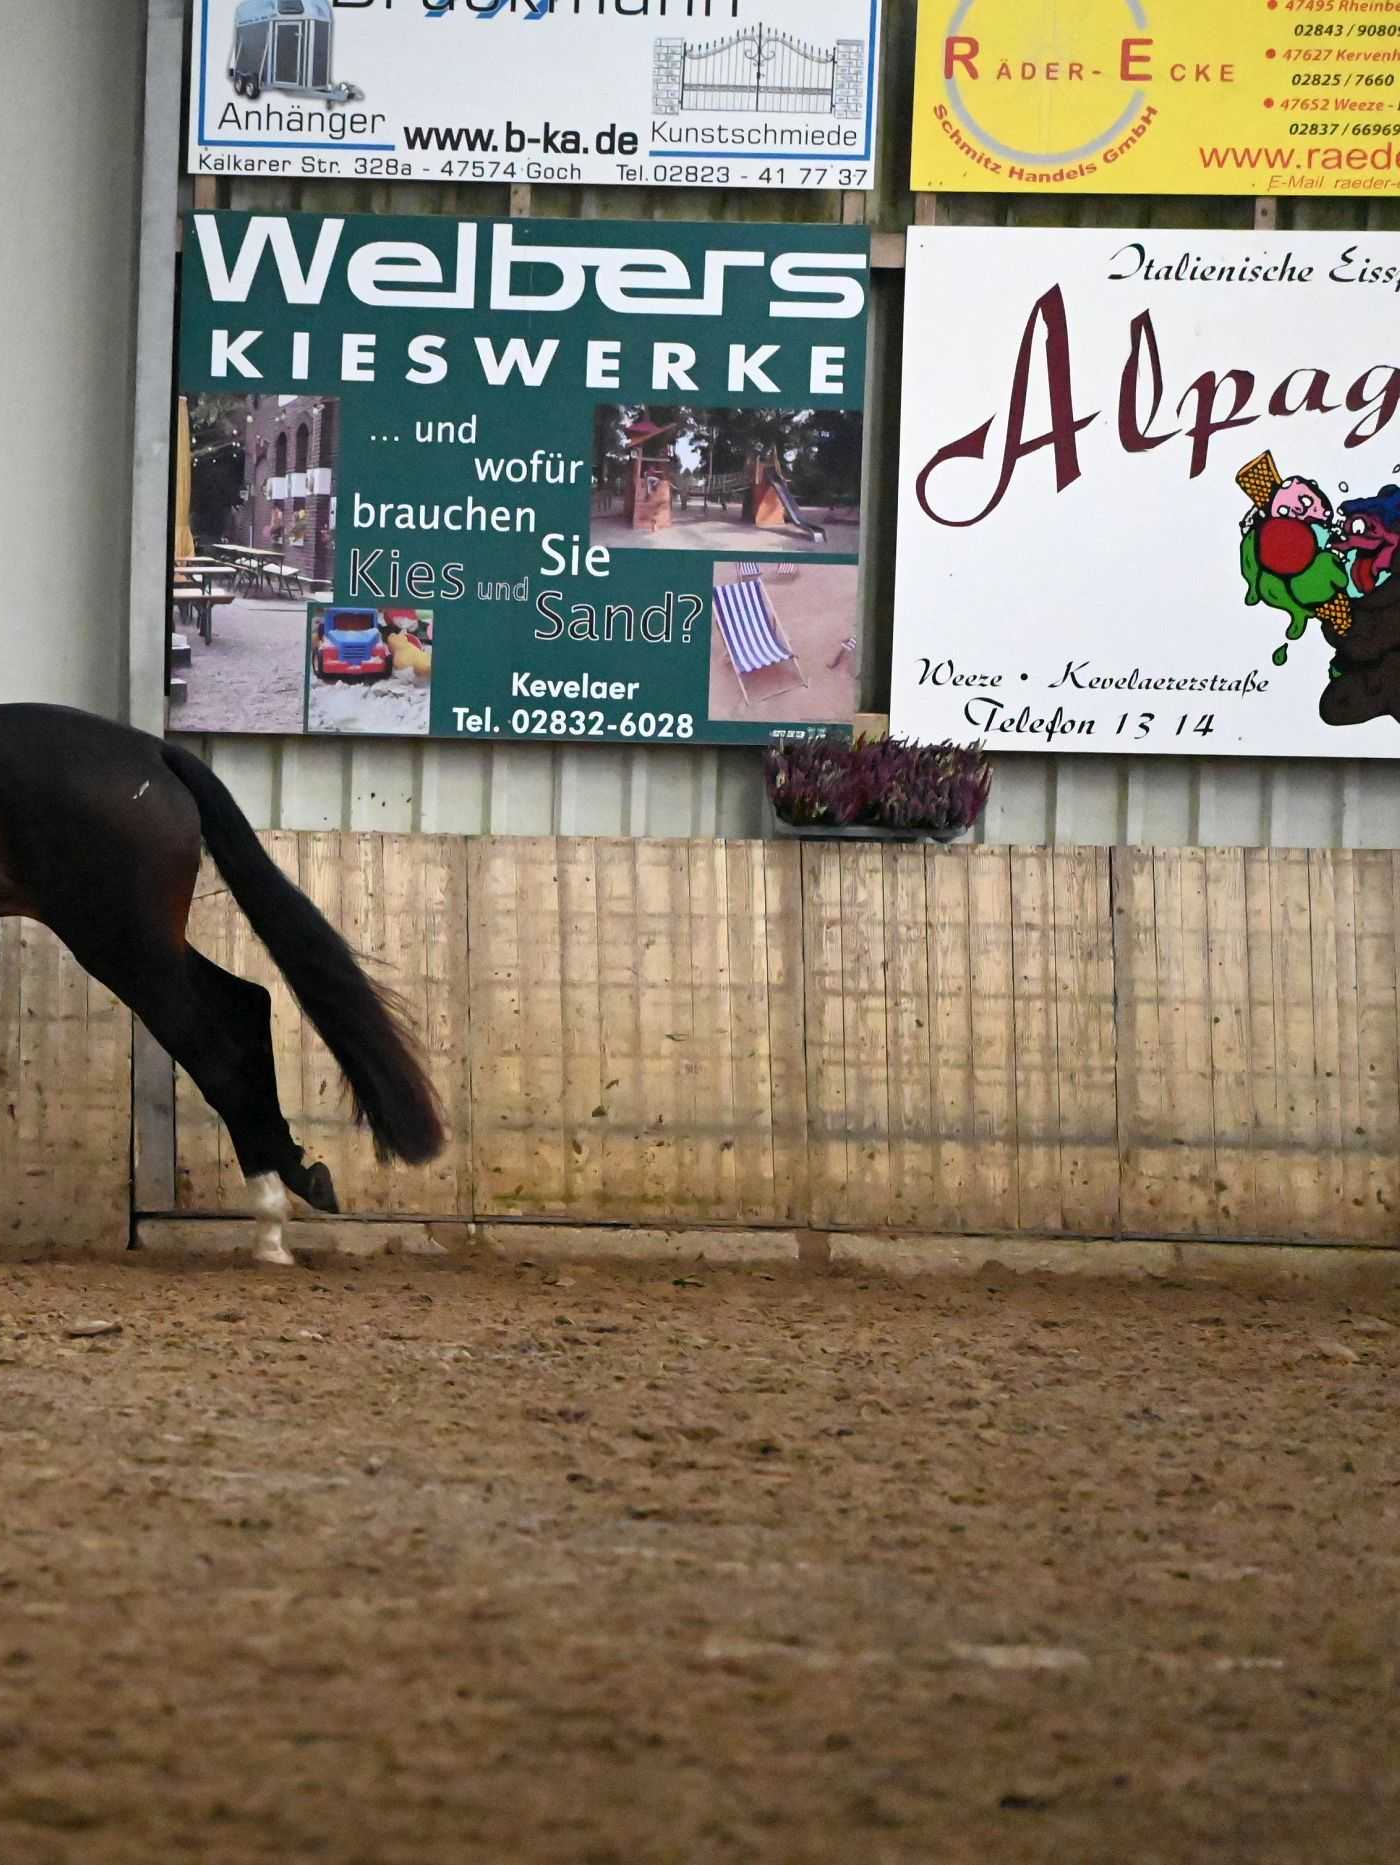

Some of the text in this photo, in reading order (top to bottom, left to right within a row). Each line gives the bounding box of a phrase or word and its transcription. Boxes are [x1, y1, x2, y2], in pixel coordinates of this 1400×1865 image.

[1285, 0, 1334, 12] 47495
[1294, 24, 1344, 37] 02843
[1282, 49, 1400, 62] 47627 Kervenh
[1291, 74, 1341, 87] 02825
[1354, 74, 1395, 87] 7660
[218, 102, 386, 140] Anhänger
[1280, 98, 1330, 111] 47652
[1334, 98, 1384, 111] Weeze
[403, 121, 639, 155] www.b-ka.de
[650, 120, 857, 147] Kunstschmiede
[933, 103, 1159, 183] Schmitz Handels GmbH
[1289, 123, 1339, 136] 02837
[199, 154, 291, 173] Kalkarer
[301, 157, 341, 175] Str.
[354, 158, 412, 176] 328a
[440, 160, 517, 179] 47574
[526, 163, 581, 180] Goch
[758, 168, 784, 184] 41
[799, 168, 826, 185] 77
[838, 169, 867, 186] 37
[1199, 142, 1400, 171] www.raed
[1270, 175, 1400, 190] E-Mail raeder-
[194, 214, 866, 319] Welbers
[1108, 243, 1400, 293] Italienische Eiss
[211, 329, 846, 394] KIESWERKE
[915, 283, 1400, 527] Alpag
[415, 414, 477, 444] und
[474, 450, 584, 484] wofür
[353, 492, 536, 533] brauchen
[539, 533, 610, 577] Sie
[349, 548, 530, 601] Kies und
[534, 590, 704, 643] Sand?
[511, 672, 640, 700] Kevelaer
[914, 658, 1270, 700] Weeze Kevelaererstraße
[452, 706, 694, 739] Tel. 02832-6028
[963, 697, 1215, 743] Telefon 13 14
